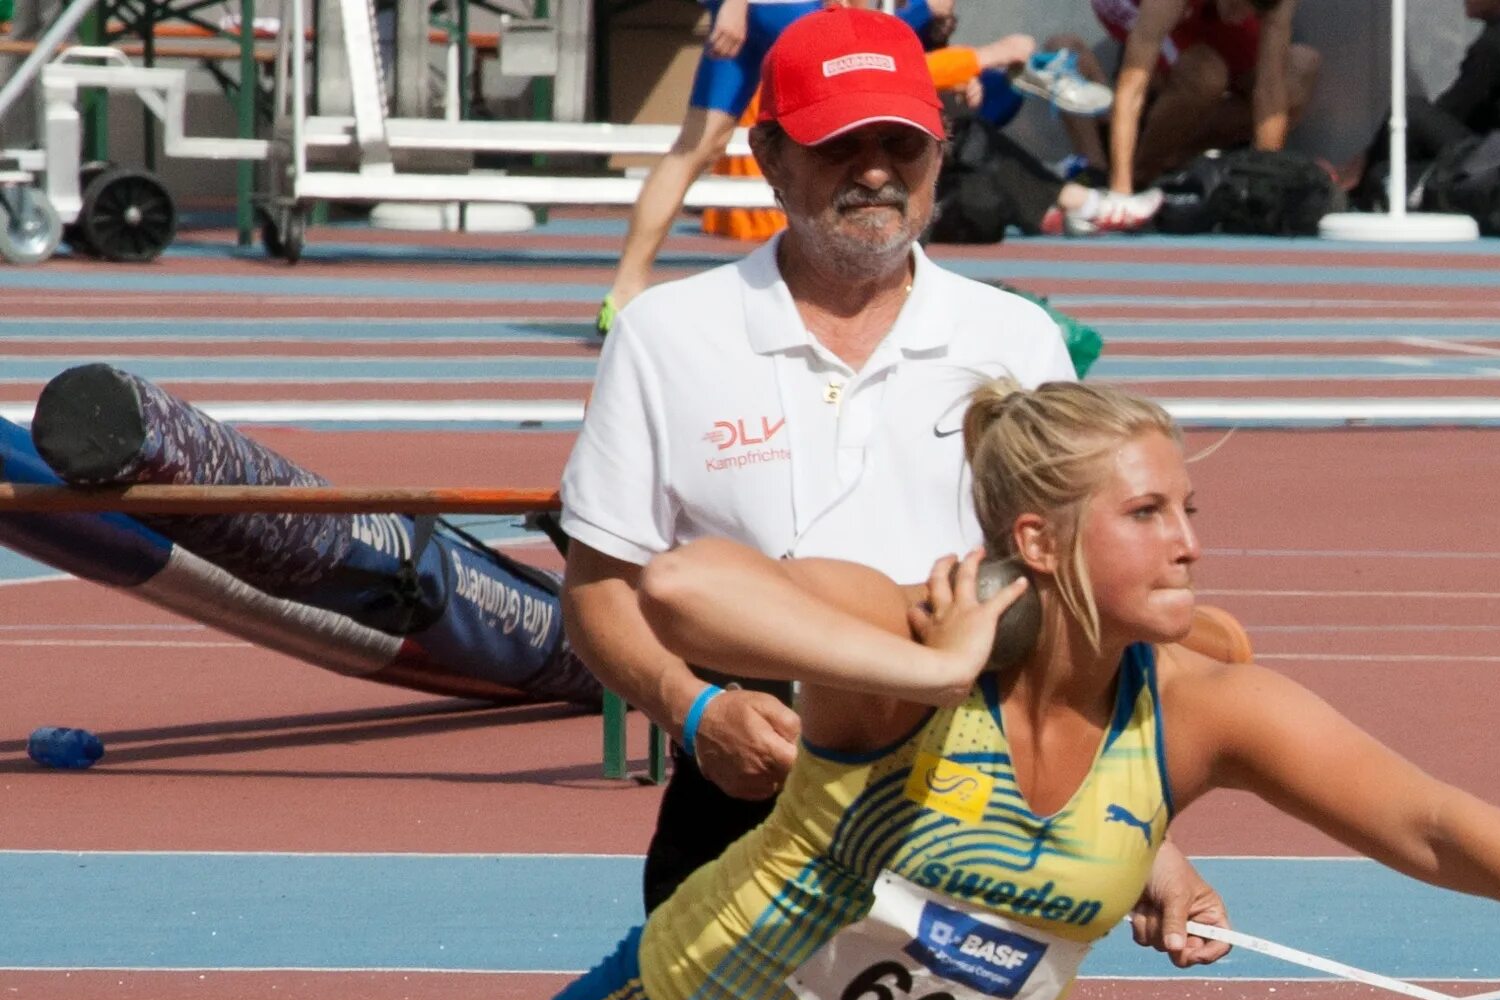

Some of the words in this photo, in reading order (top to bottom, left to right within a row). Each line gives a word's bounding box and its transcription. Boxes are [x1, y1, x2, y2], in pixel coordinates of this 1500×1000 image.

[452, 550, 521, 635] Grünberg
[523, 594, 553, 649] Kira
[918, 861, 1103, 926] sweden
[959, 934, 1029, 970] BASF
